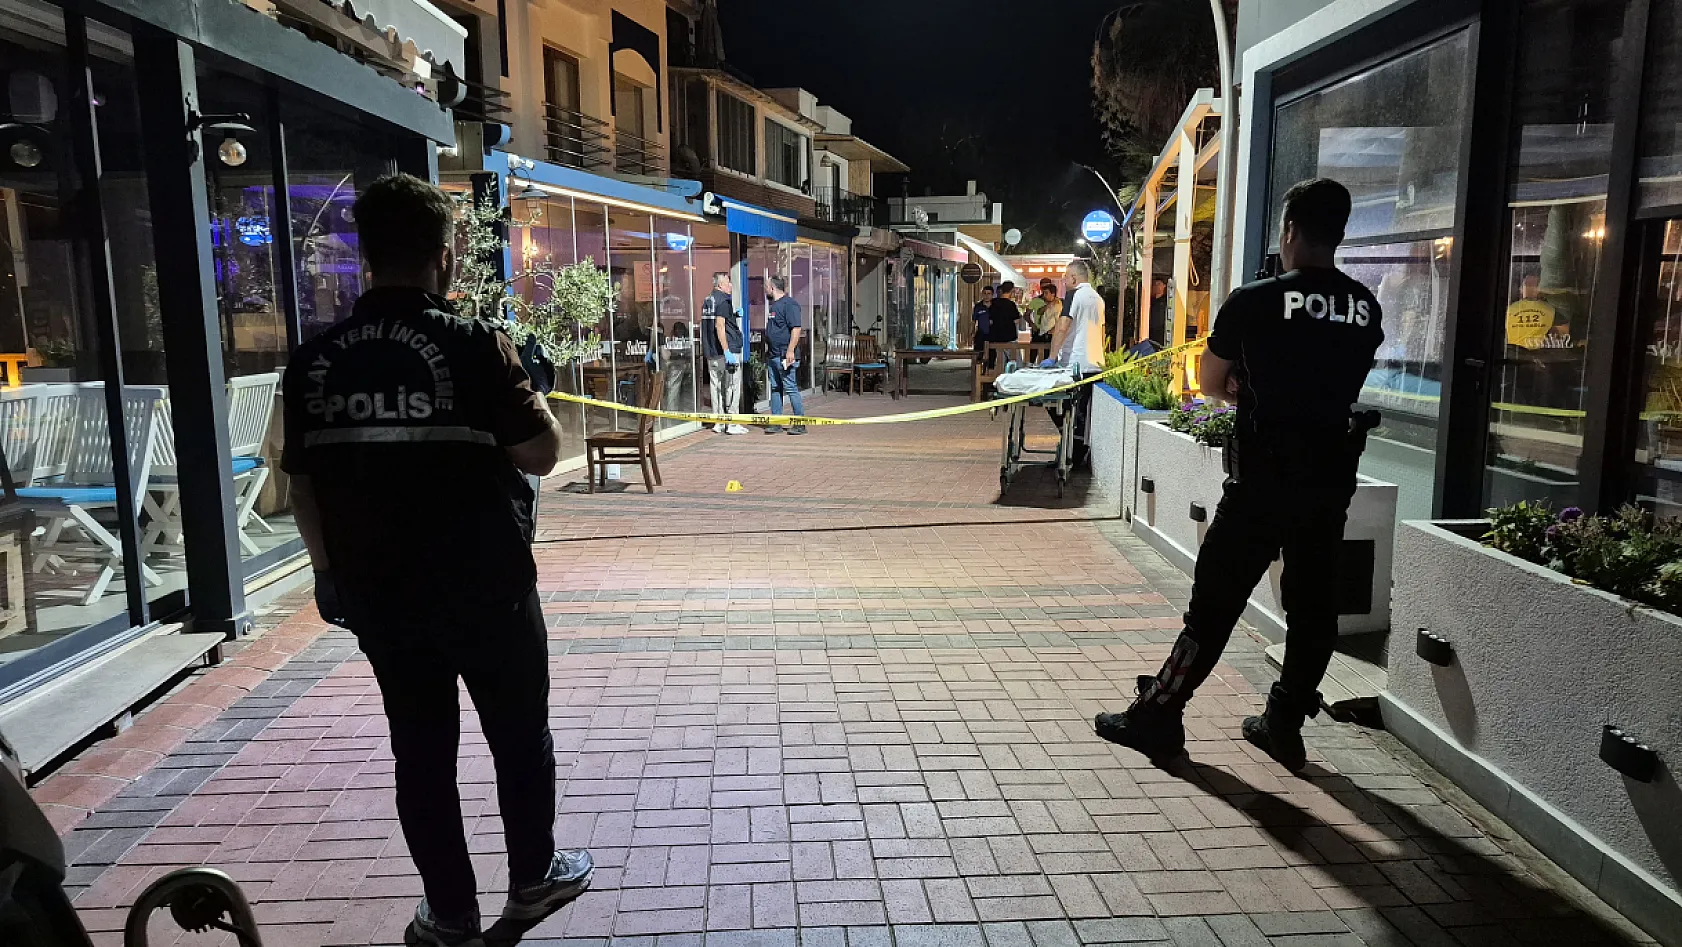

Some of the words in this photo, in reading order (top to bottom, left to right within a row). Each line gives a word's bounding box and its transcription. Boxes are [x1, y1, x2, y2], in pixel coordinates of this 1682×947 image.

[1518, 314, 1540, 324] 112
[304, 353, 332, 415] OLAY
[332, 318, 384, 350] YERİ
[389, 319, 454, 411] İNCELEME
[325, 384, 433, 422] POLİS
